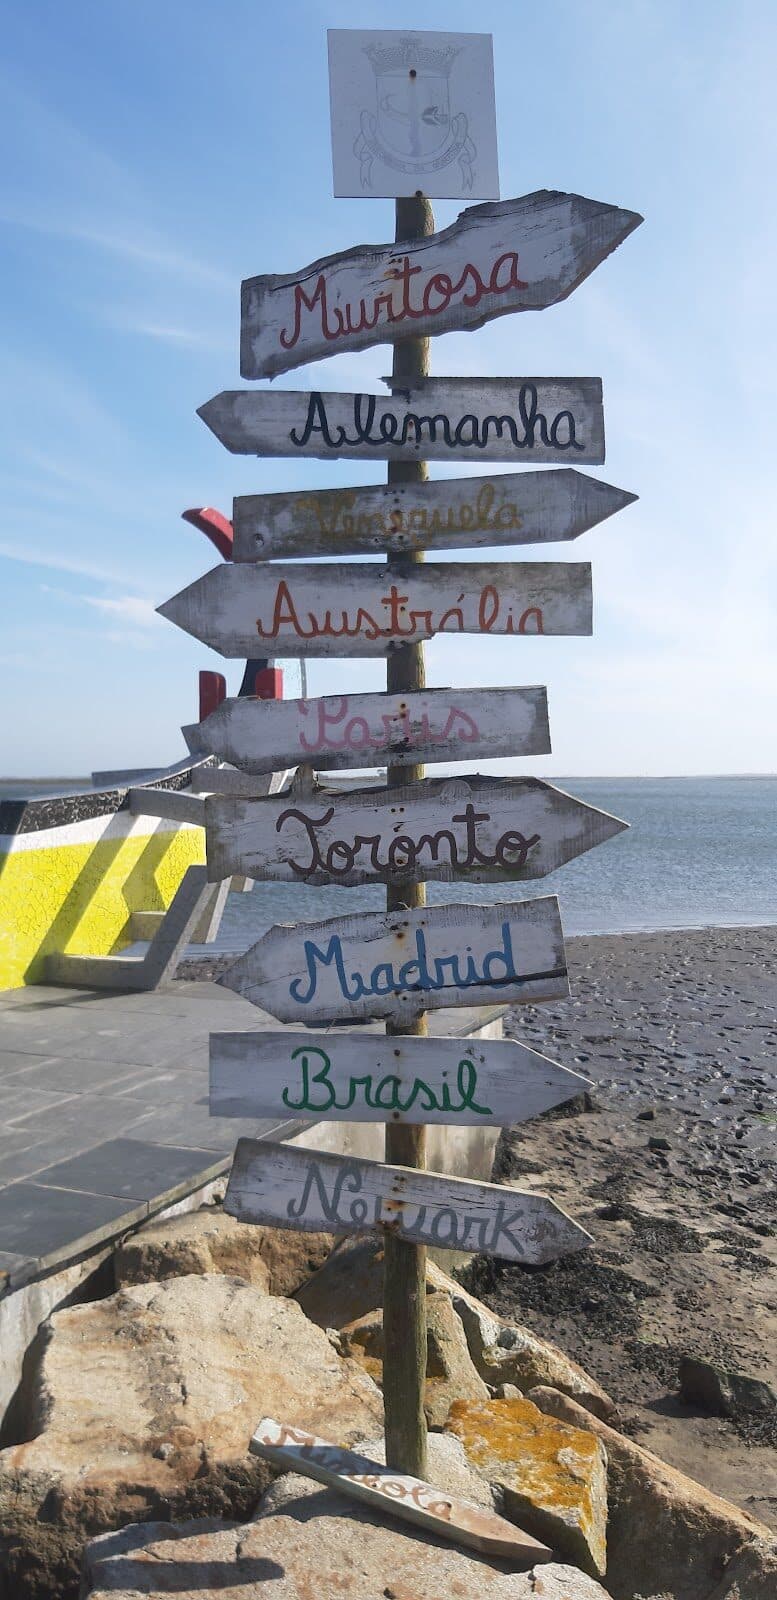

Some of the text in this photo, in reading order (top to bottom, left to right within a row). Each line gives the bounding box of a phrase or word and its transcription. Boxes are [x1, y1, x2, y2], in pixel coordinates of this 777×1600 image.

[280, 252, 529, 349] Murtosa
[289, 383, 585, 451] Alemanha
[256, 580, 544, 640] Austrália
[298, 696, 480, 752] Paris
[275, 803, 541, 876] Toronto
[289, 922, 524, 1003] Madrid
[282, 1046, 493, 1115] Brasil
[286, 1163, 525, 1255] Newark
